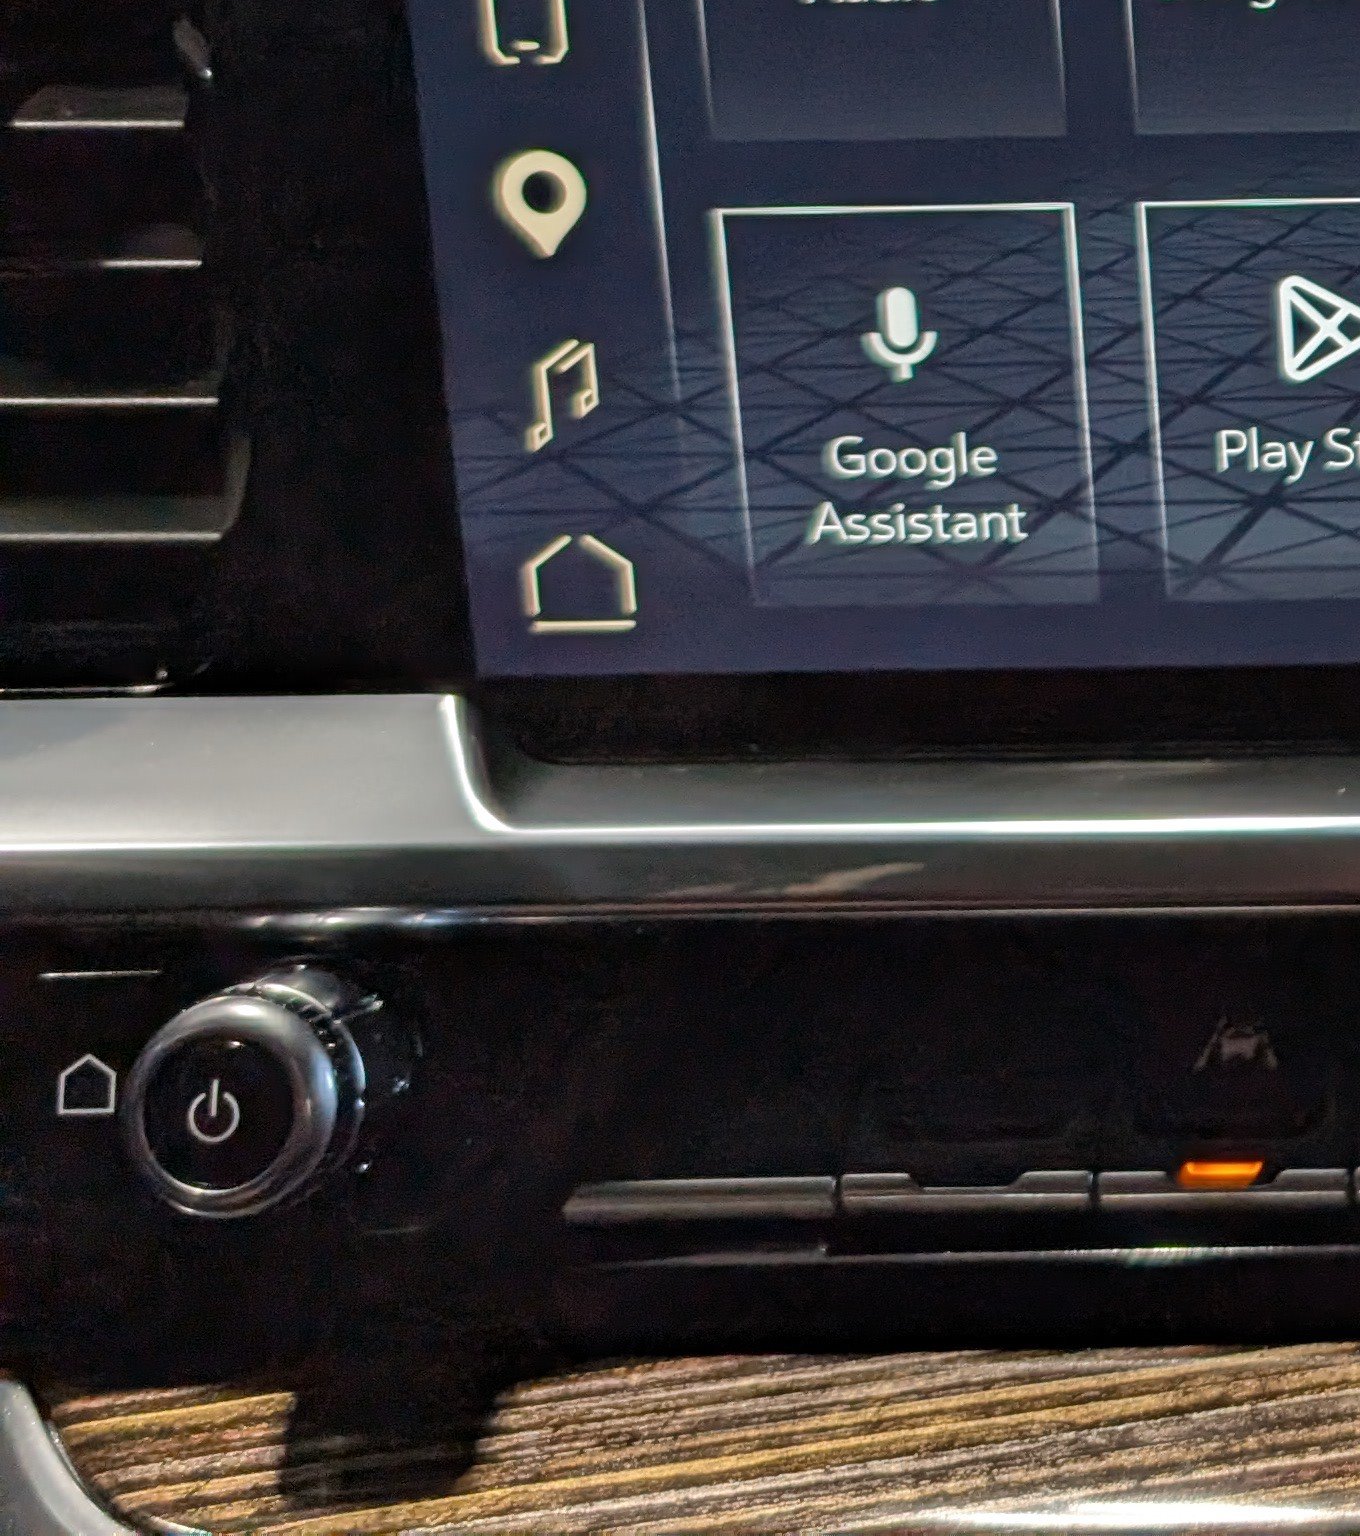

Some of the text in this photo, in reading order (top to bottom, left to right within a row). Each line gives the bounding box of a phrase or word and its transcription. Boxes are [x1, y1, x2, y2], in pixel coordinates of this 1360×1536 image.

[829, 432, 997, 489] Google
[1218, 427, 1313, 482] Play
[809, 502, 1028, 543] Assistant
